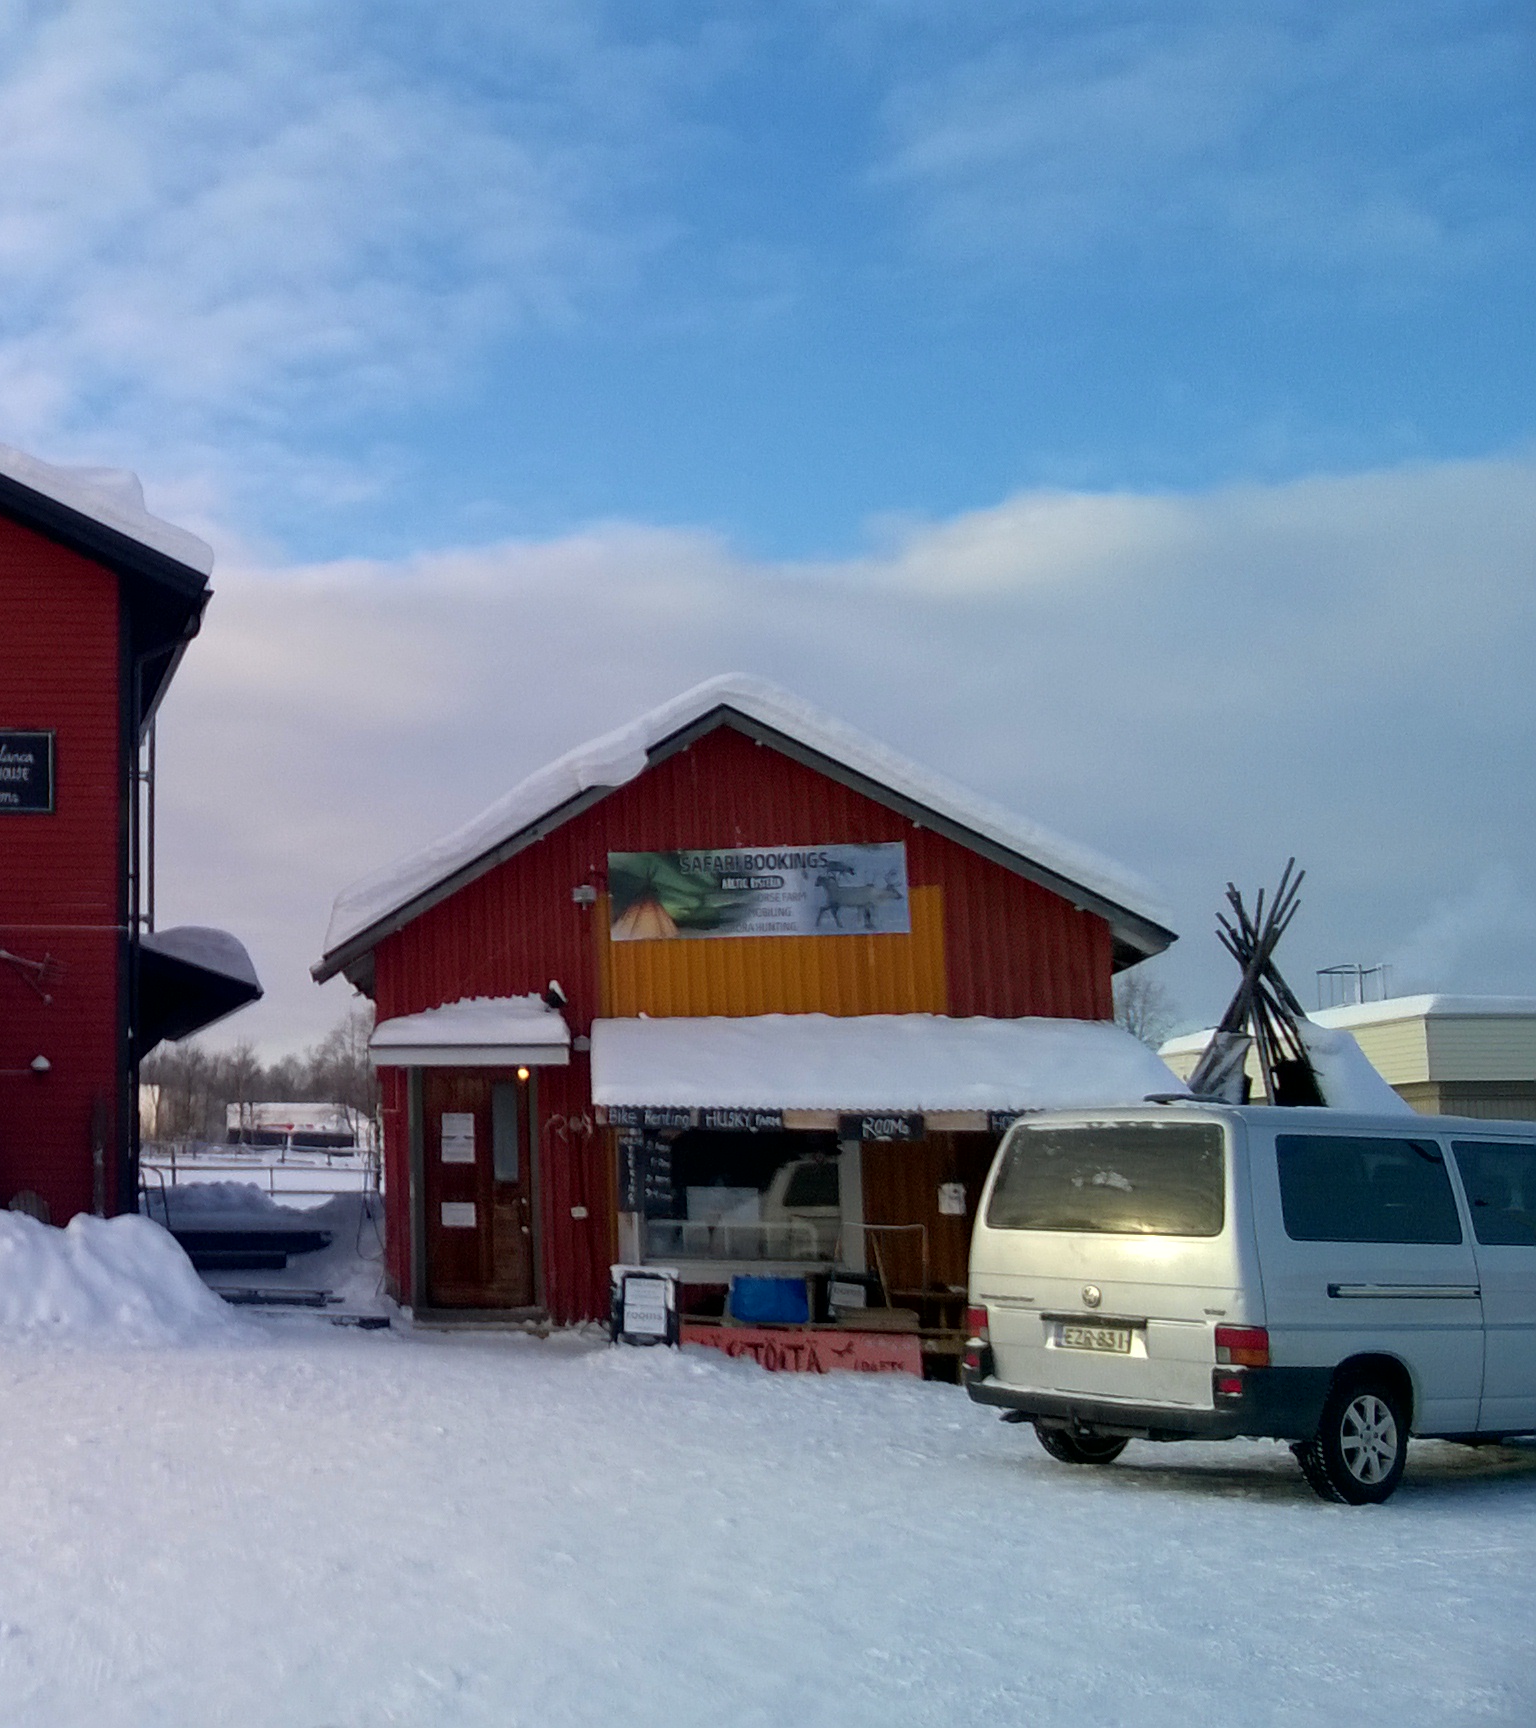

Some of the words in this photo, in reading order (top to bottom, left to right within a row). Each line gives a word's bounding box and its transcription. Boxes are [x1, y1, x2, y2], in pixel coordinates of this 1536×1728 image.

[680, 855, 739, 874] SAFARI
[744, 851, 828, 872] BOOKINGS
[608, 1108, 637, 1125] Bike
[644, 1109, 690, 1128] Renting
[705, 1110, 750, 1127] HUSKY
[755, 1114, 781, 1127] FARM
[627, 1311, 663, 1321] rooms
